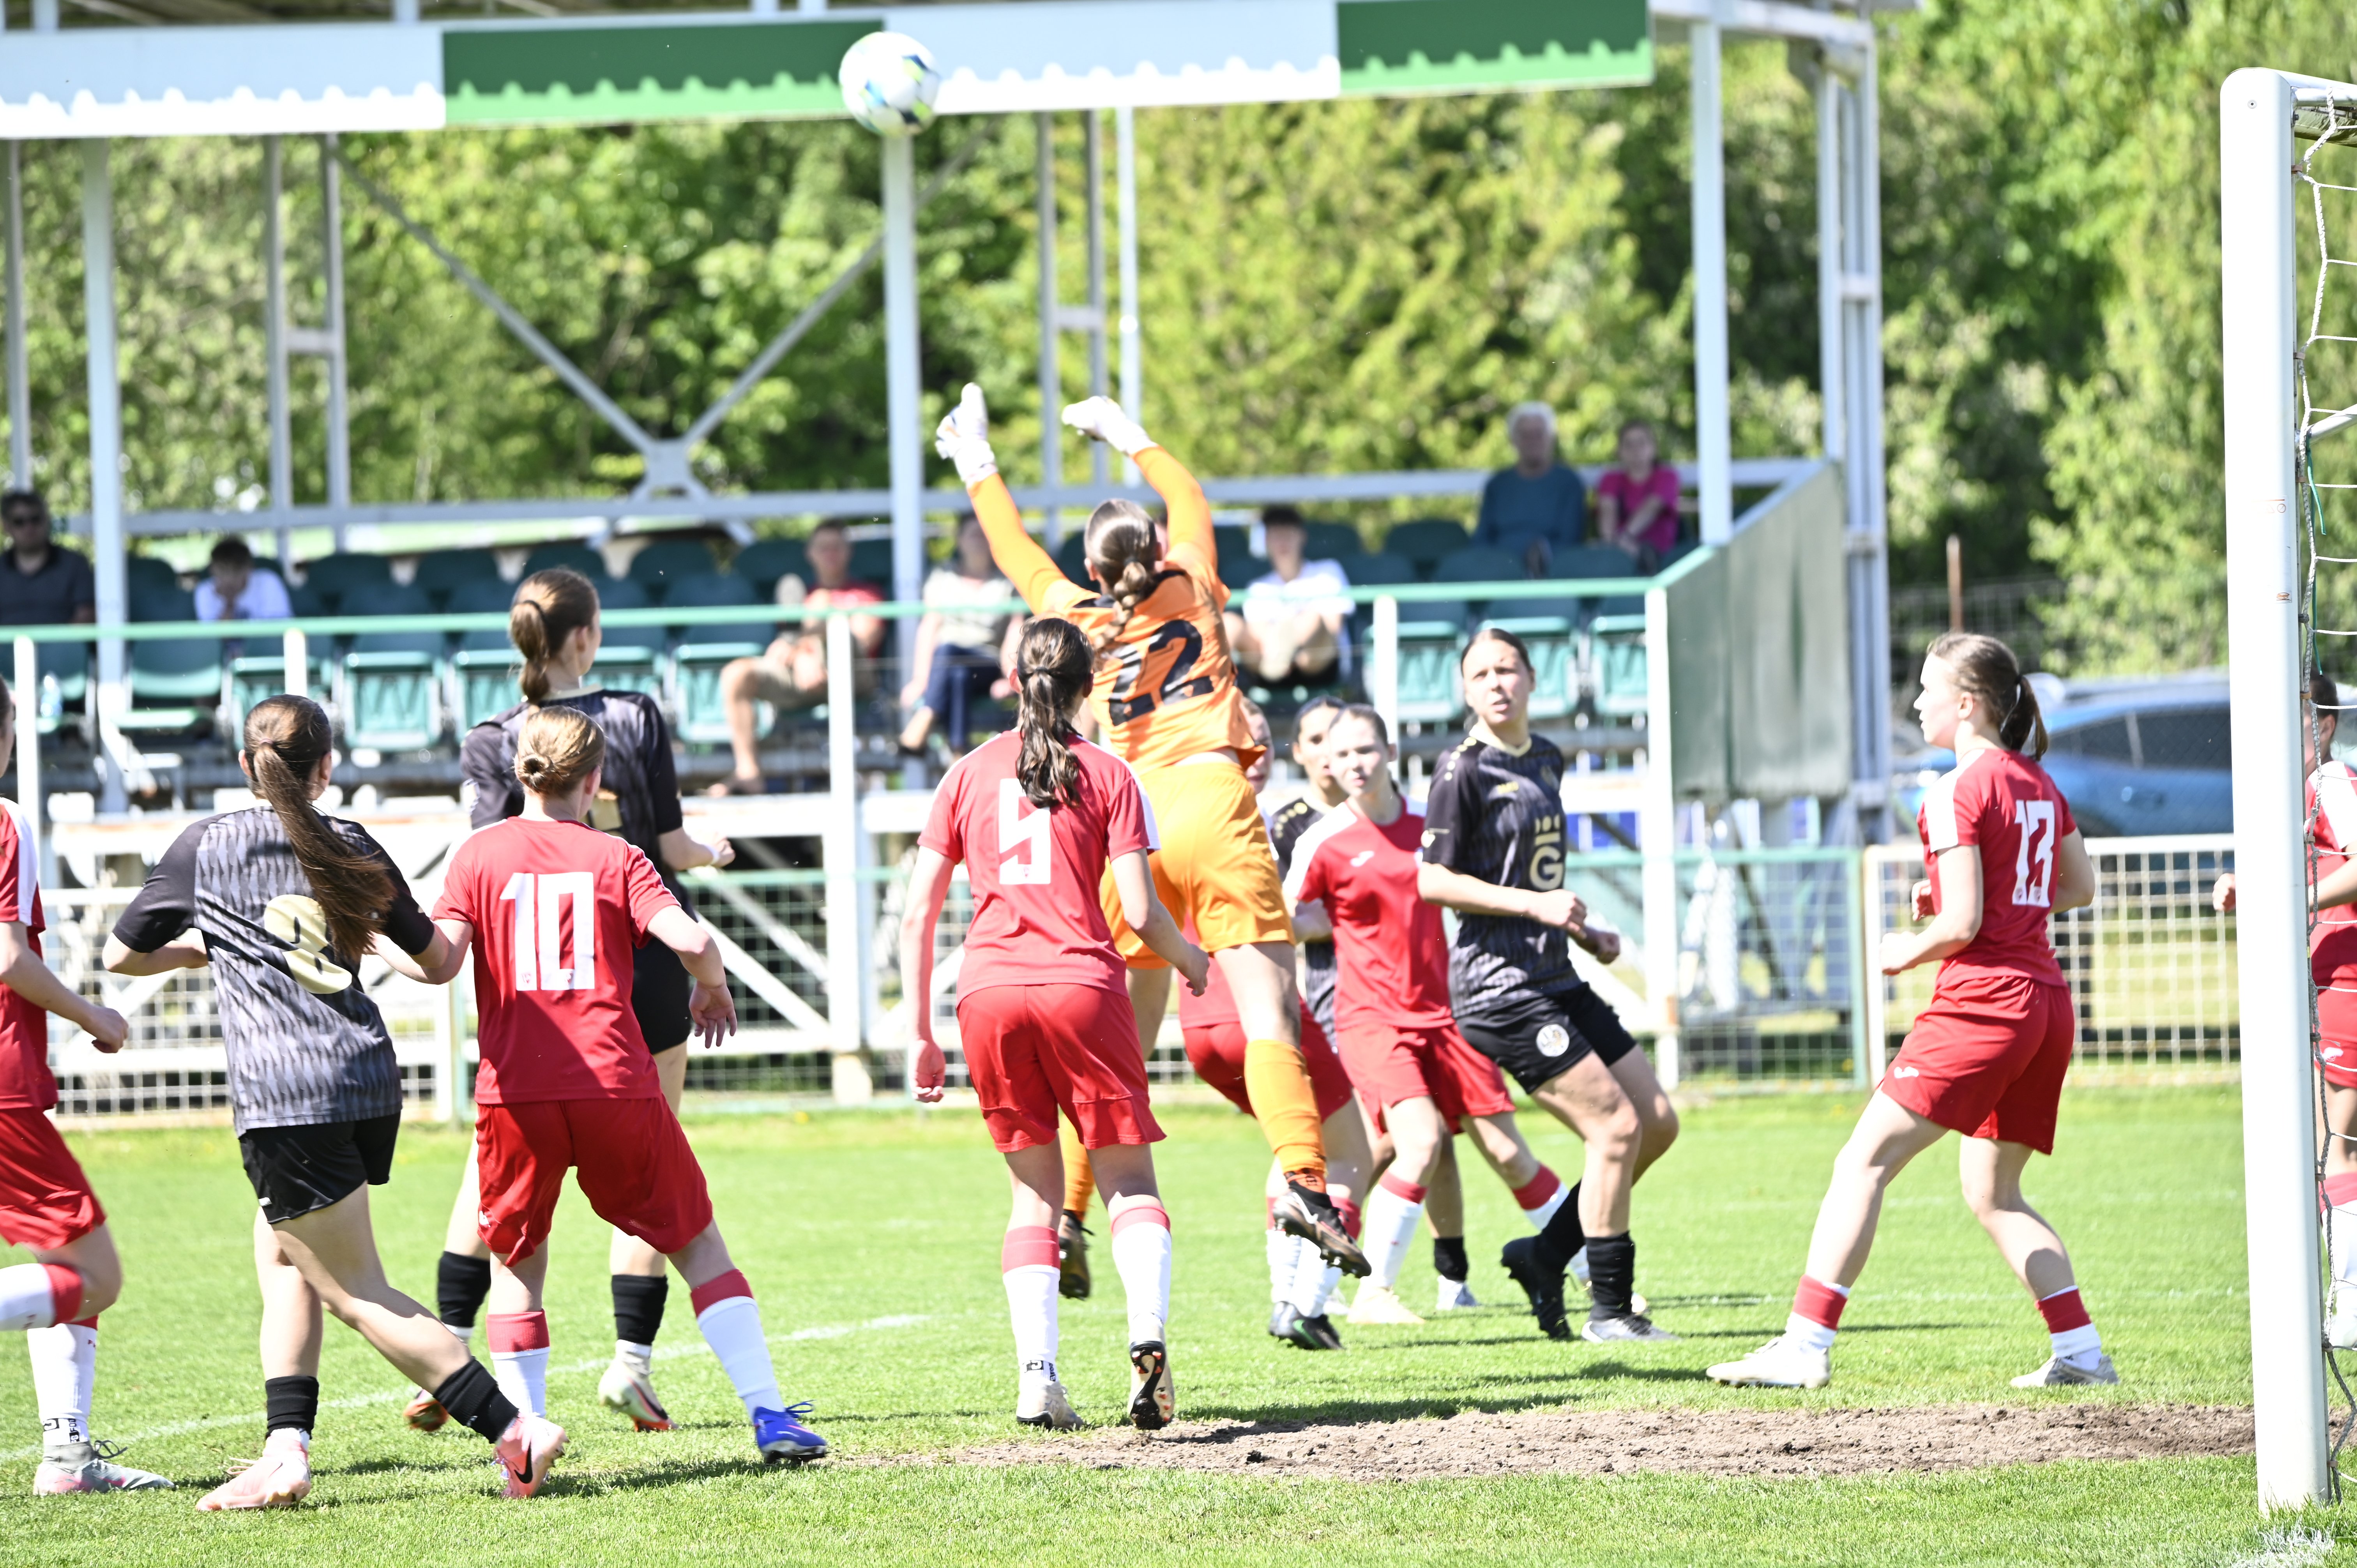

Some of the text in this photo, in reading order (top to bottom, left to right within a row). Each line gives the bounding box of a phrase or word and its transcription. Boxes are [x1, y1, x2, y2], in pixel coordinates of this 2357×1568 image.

[1102, 619, 1214, 727] 22
[998, 778, 1051, 885] 5
[1530, 846, 1564, 891] G
[2012, 800, 2055, 908] 13
[499, 872, 595, 991] 10
